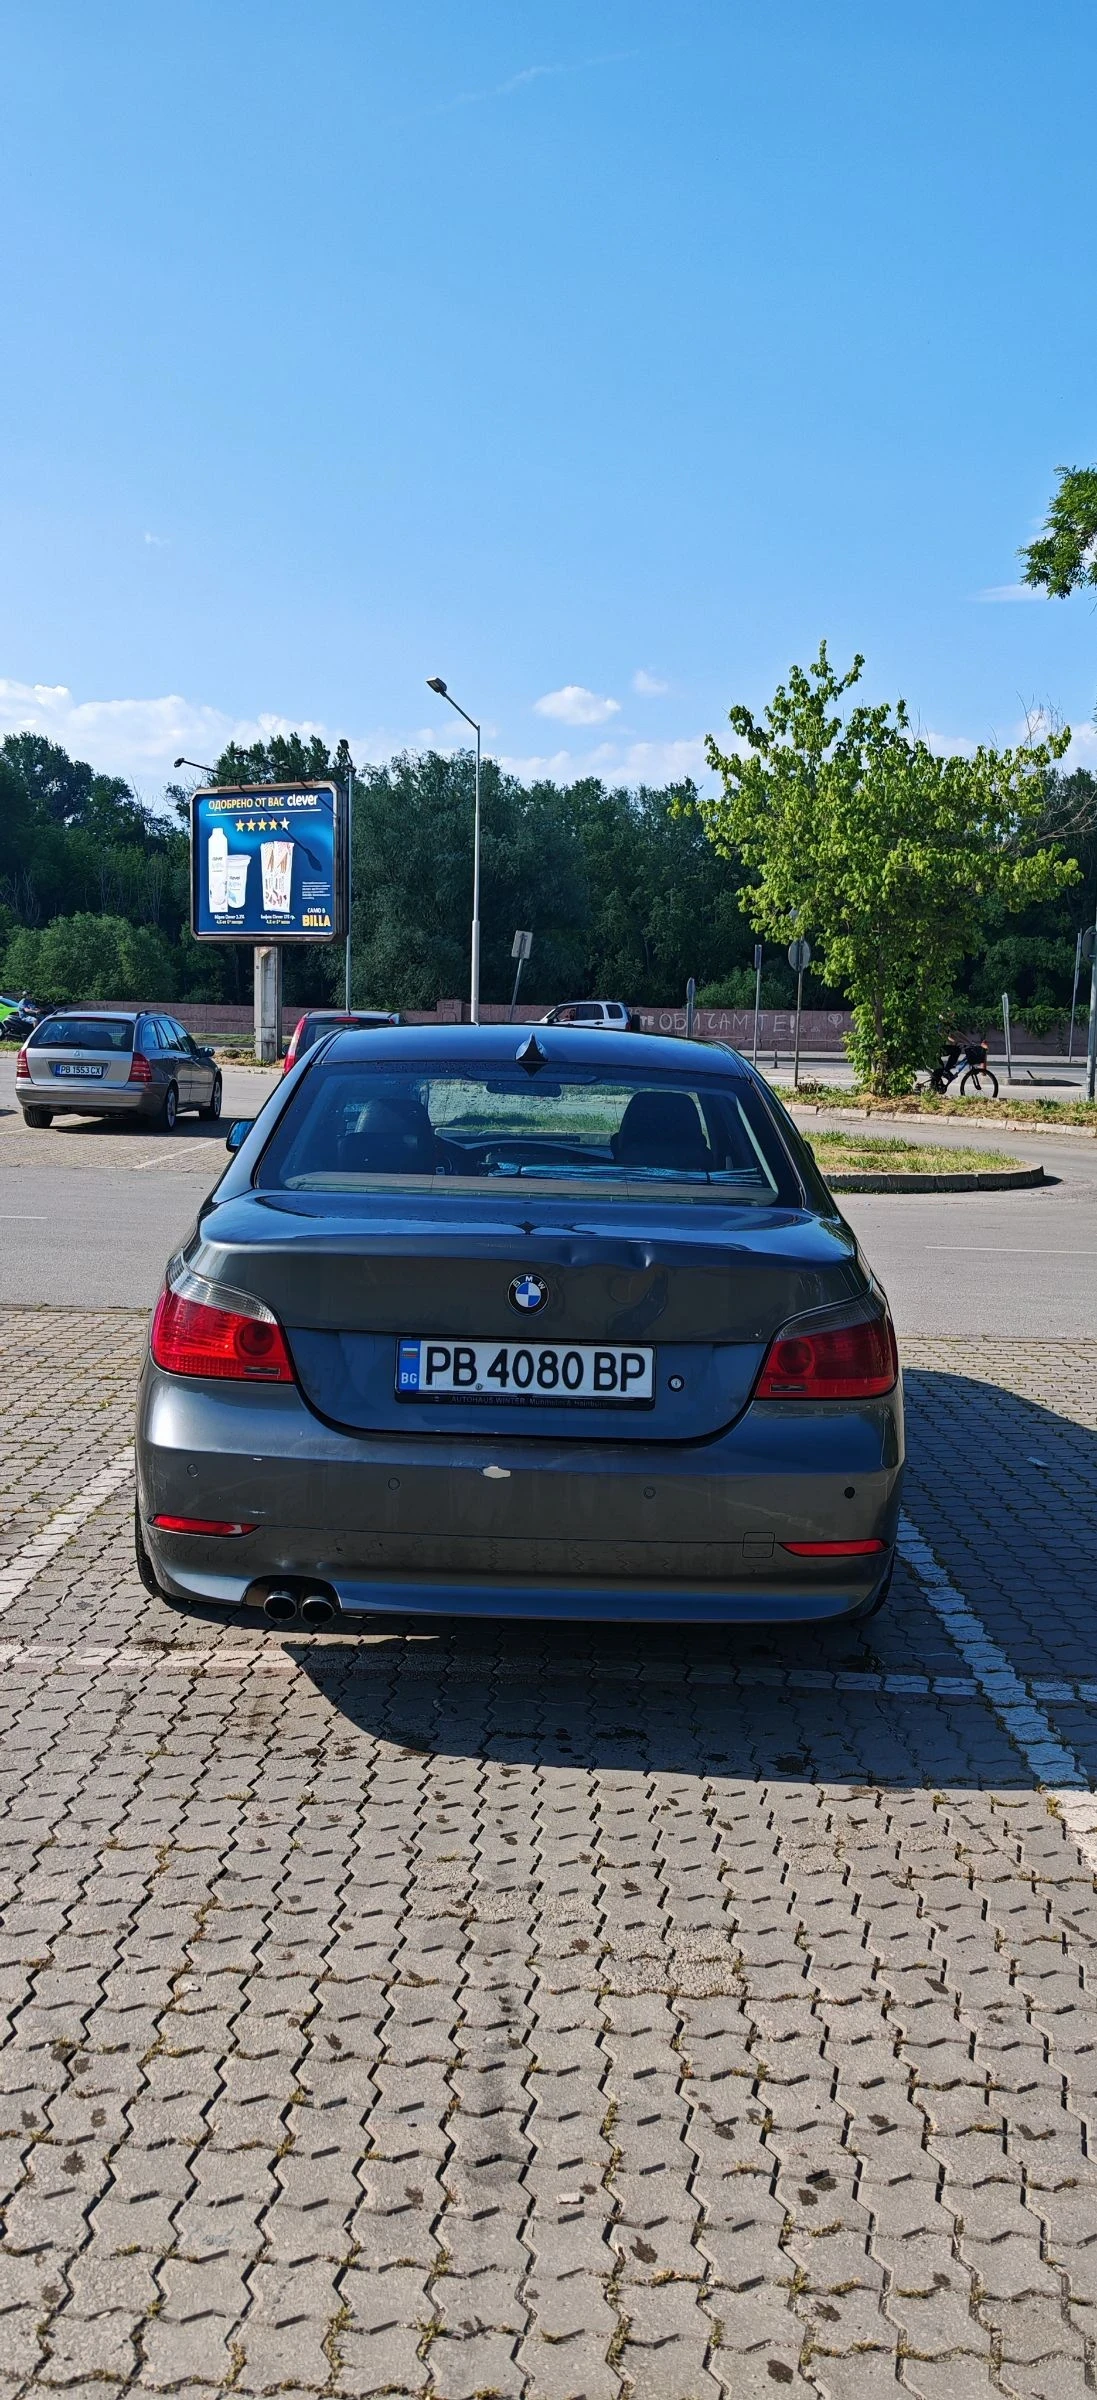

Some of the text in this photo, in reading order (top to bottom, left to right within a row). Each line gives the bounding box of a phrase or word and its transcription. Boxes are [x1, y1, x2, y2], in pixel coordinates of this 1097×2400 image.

[208, 793, 318, 811] ОДОБРЕНО ОТ ВАС clever
[302, 914, 331, 927] BILLA
[61, 1065, 101, 1075] PB 1553 CX
[512, 1275, 546, 1290] BMW
[425, 1346, 646, 1392] PB 4080 BP
[401, 1372, 418, 1385] BG
[450, 1395, 494, 1405] AUTOHAUS
[495, 1396, 525, 1406] WINTER
